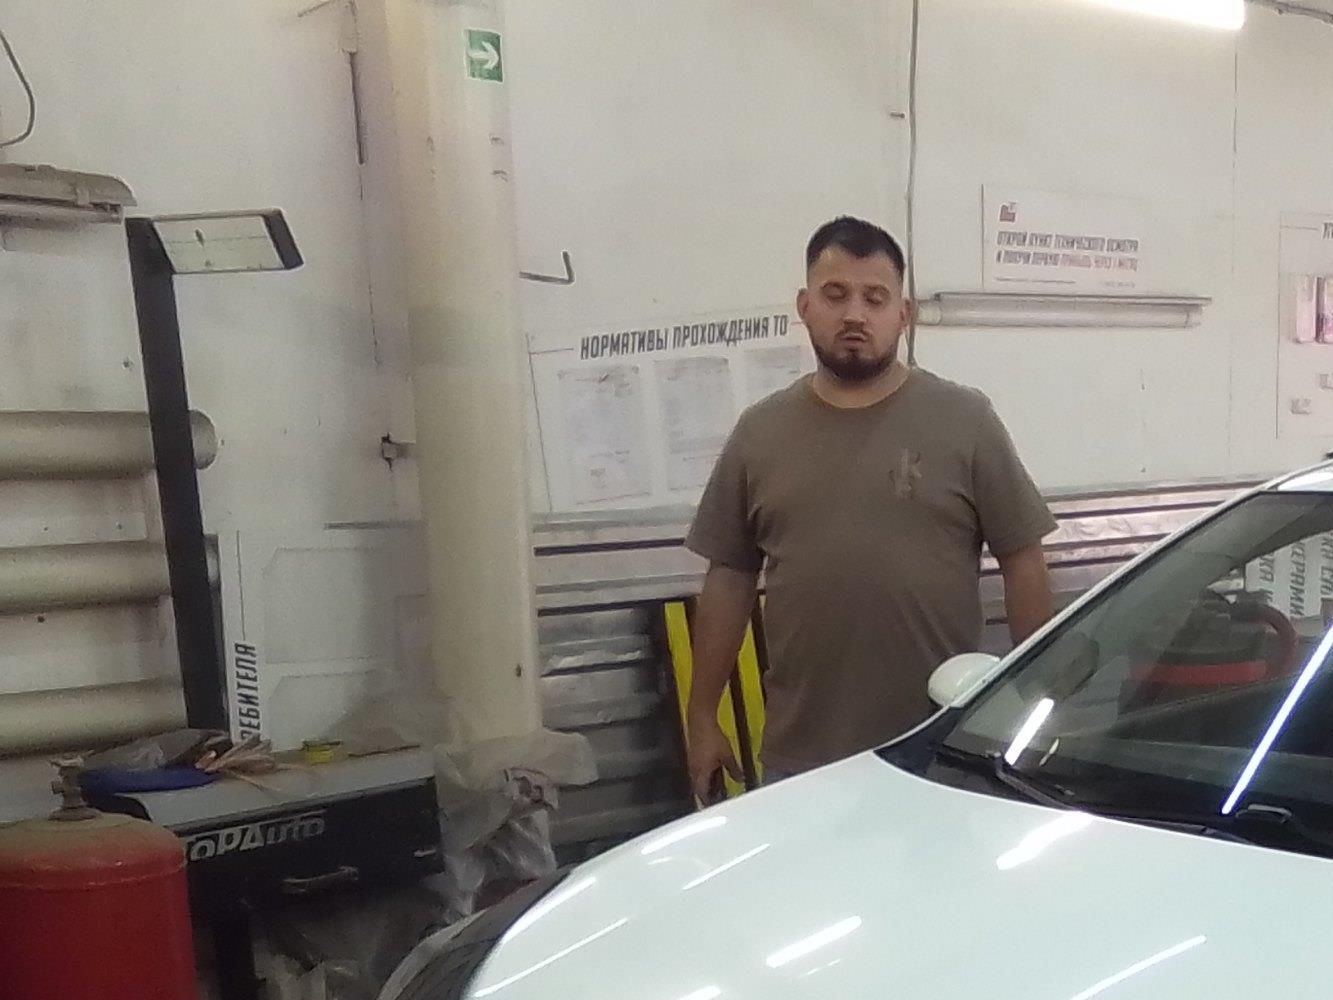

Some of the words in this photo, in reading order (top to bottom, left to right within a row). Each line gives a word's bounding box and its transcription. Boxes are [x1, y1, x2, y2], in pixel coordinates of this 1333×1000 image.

[580, 328, 668, 360] НОРМАТИВЫ
[672, 317, 769, 348] ПРОХОЖДЕНИЯ
[773, 314, 788, 337] ТО
